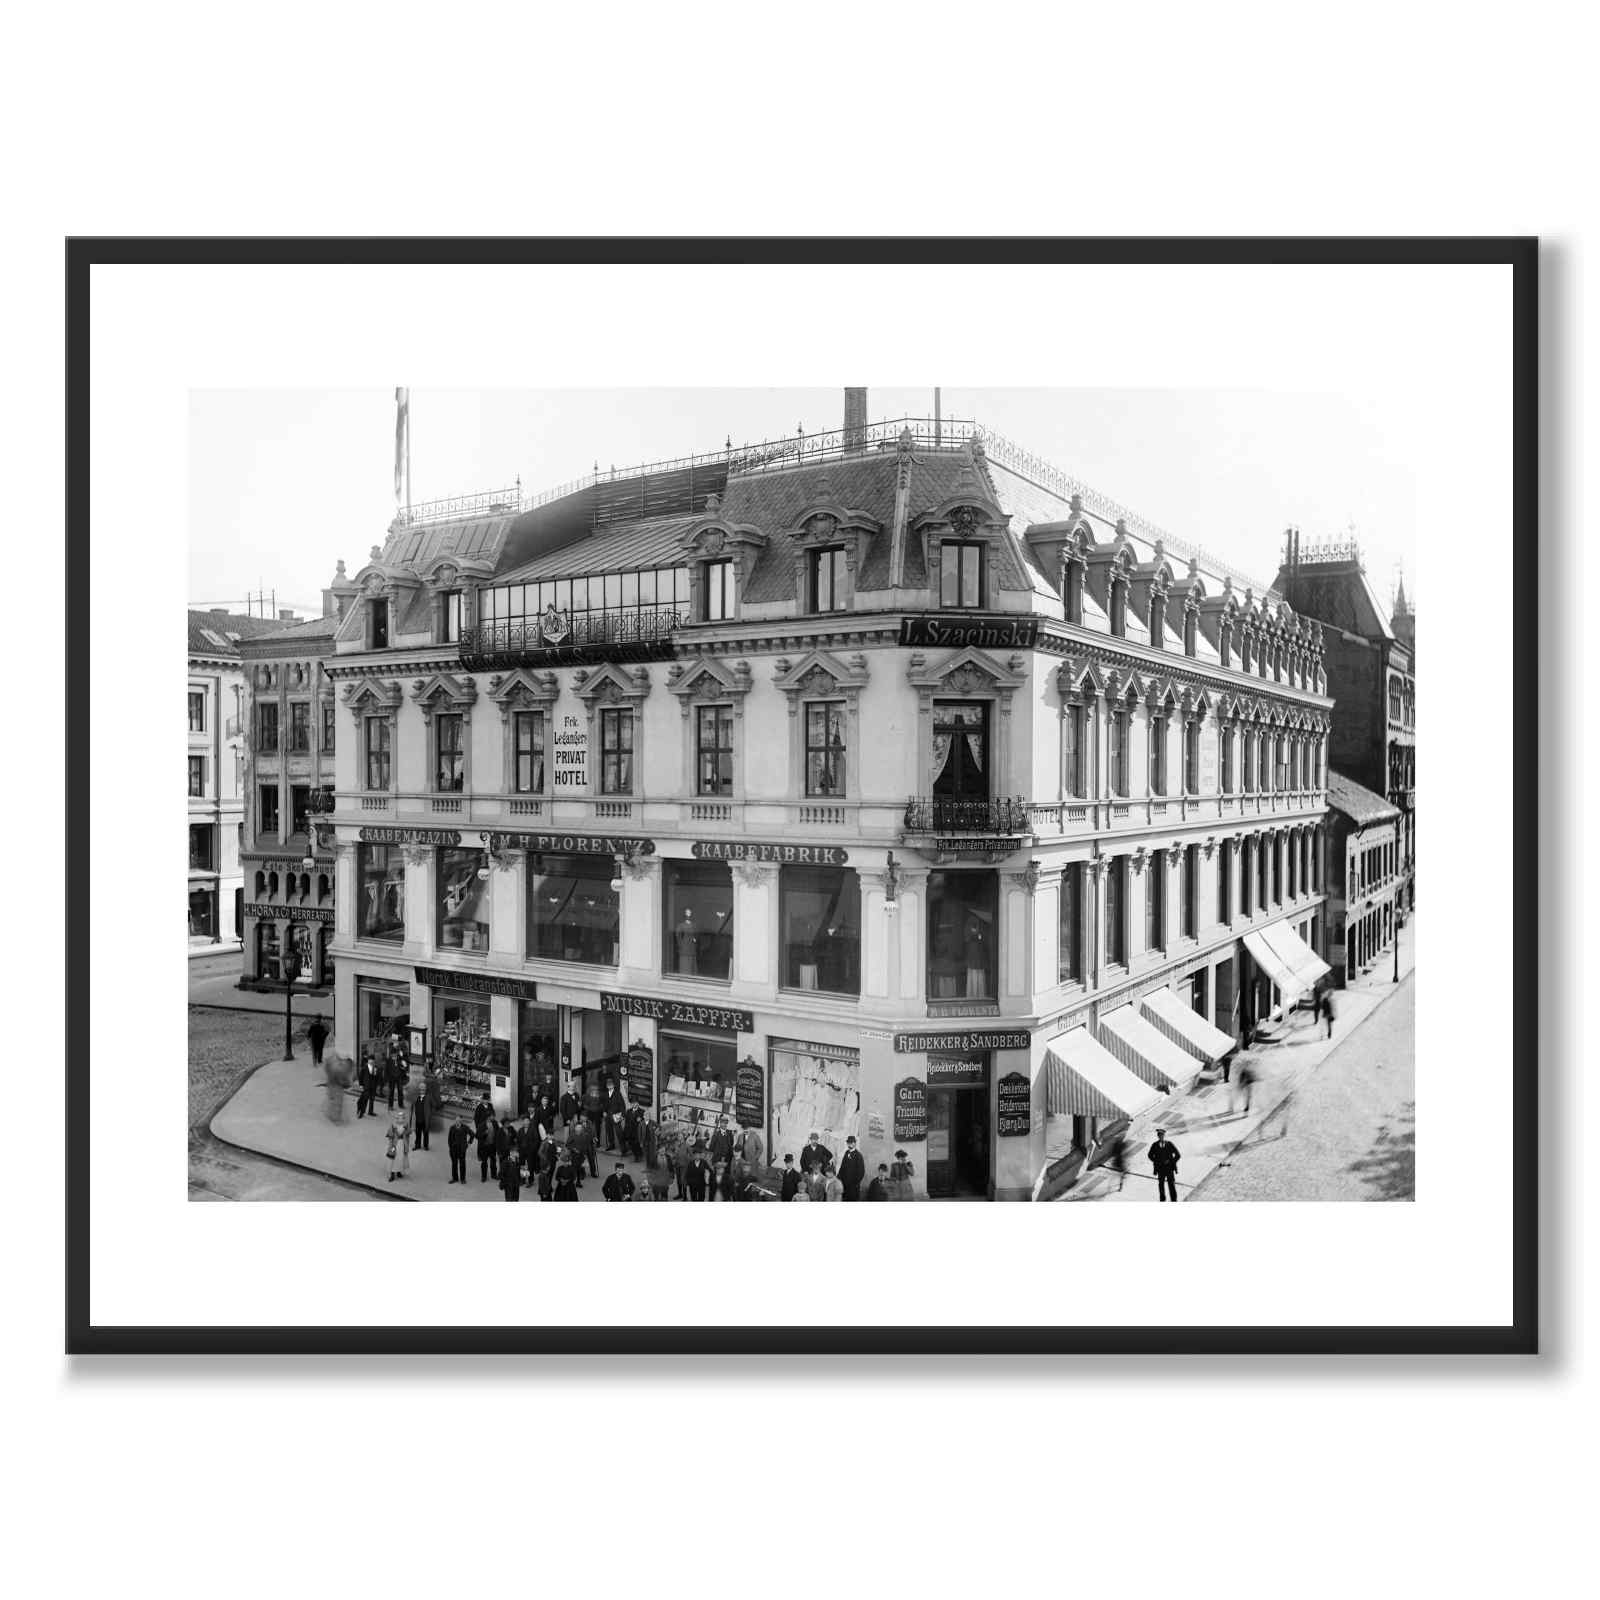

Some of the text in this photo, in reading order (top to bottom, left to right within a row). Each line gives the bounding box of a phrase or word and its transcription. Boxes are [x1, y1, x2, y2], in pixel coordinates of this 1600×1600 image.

[556, 750, 587, 764] PRIVAT
[554, 770, 588, 785] HOTEL
[519, 835, 530, 849] H
[701, 842, 837, 864] KAABEFABRIK
[606, 995, 744, 1030] MUSIK ZAPFFE
